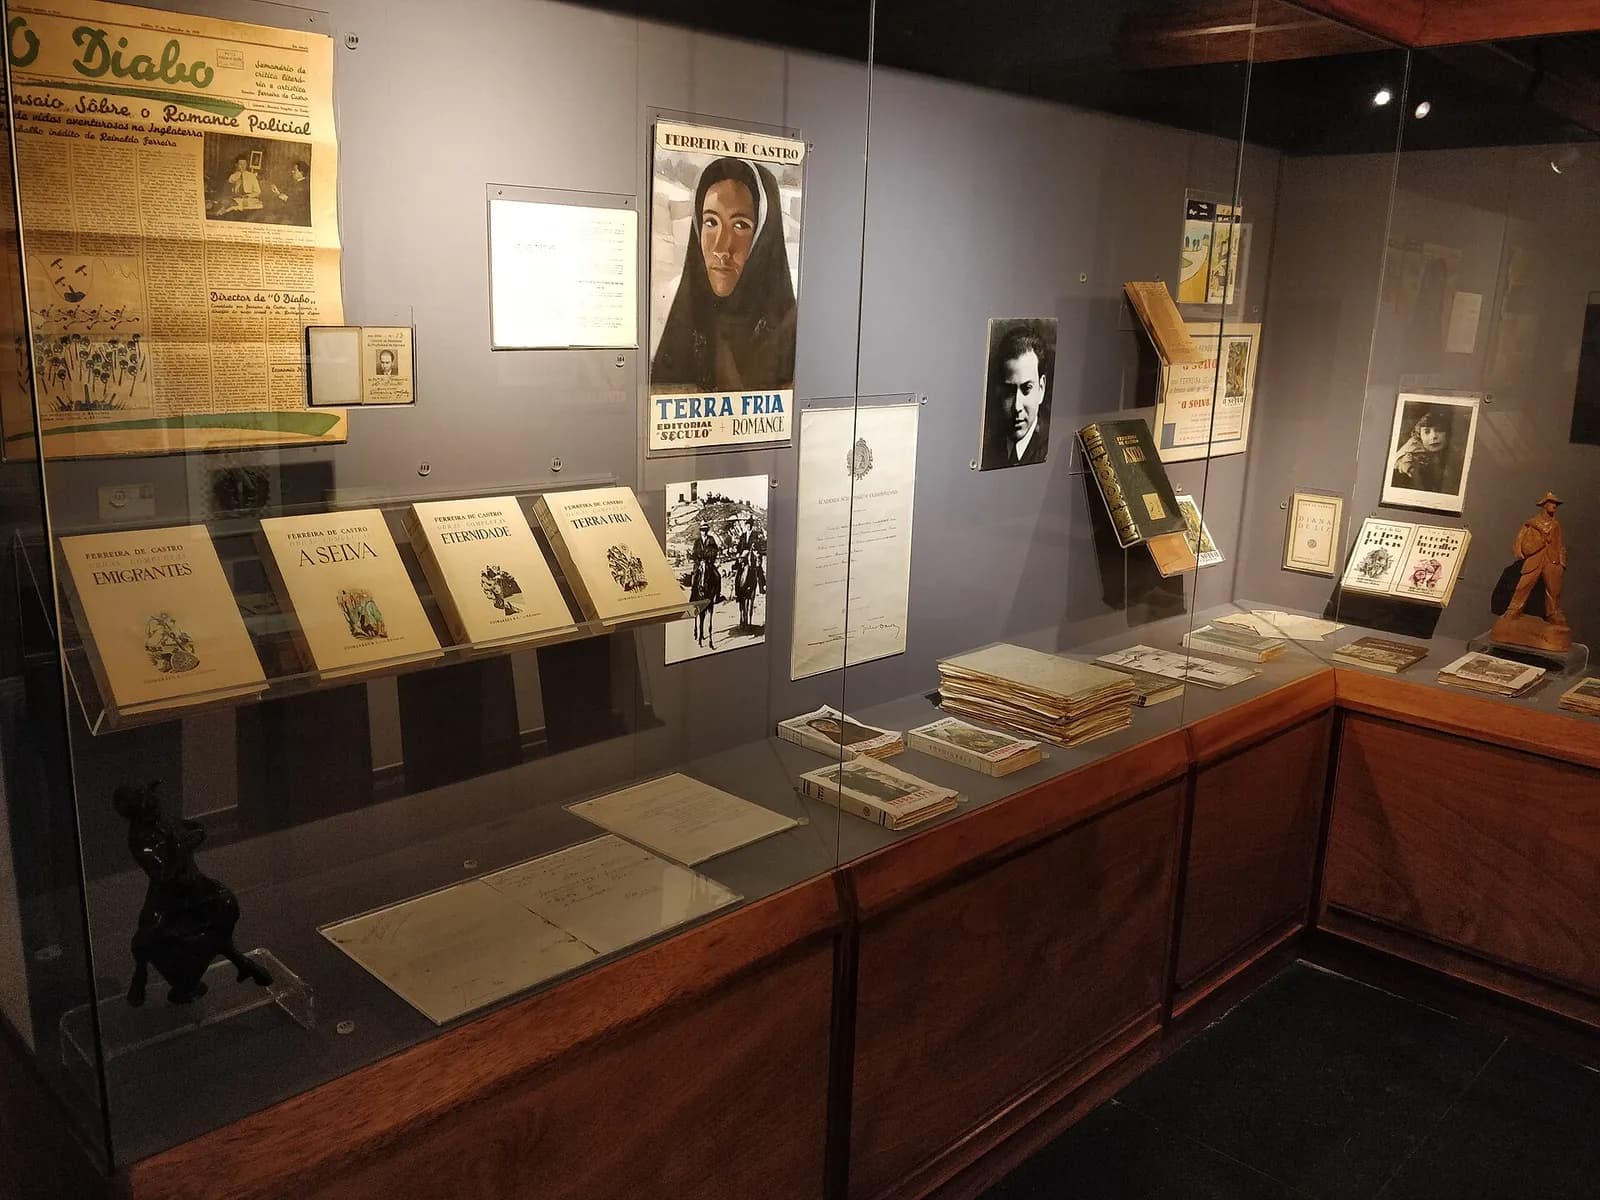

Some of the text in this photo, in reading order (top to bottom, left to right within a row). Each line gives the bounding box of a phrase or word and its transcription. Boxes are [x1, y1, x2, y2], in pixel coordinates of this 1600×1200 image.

[8, 16, 214, 88] O Diabo
[14, 94, 64, 108] nsaio
[75, 96, 131, 116] Sôbre
[141, 108, 150, 118] o
[163, 105, 239, 127] Romance
[248, 115, 311, 135] Policial
[148, 122, 203, 138] Inglaterra
[143, 136, 176, 147] Ferreira
[665, 133, 799, 160] FERREIRA DE CASTRO
[210, 291, 251, 302] Director
[254, 293, 265, 302] de
[656, 394, 784, 420] TERRA FRIA
[657, 420, 712, 431] EDITORIAL
[732, 416, 784, 436] ROMANCE
[434, 515, 466, 523] FERREIRA
[477, 511, 503, 519] CASTRO
[570, 513, 632, 529] TERRA FRIA
[287, 531, 325, 540] FERREIRA
[341, 526, 368, 535] CASTRO
[440, 526, 512, 544] ETERNIDADE
[85, 550, 130, 560] FERREIRA
[150, 545, 184, 553] CASTRO
[299, 542, 378, 567] A SELVA
[92, 563, 192, 585] EMIGRANTES
